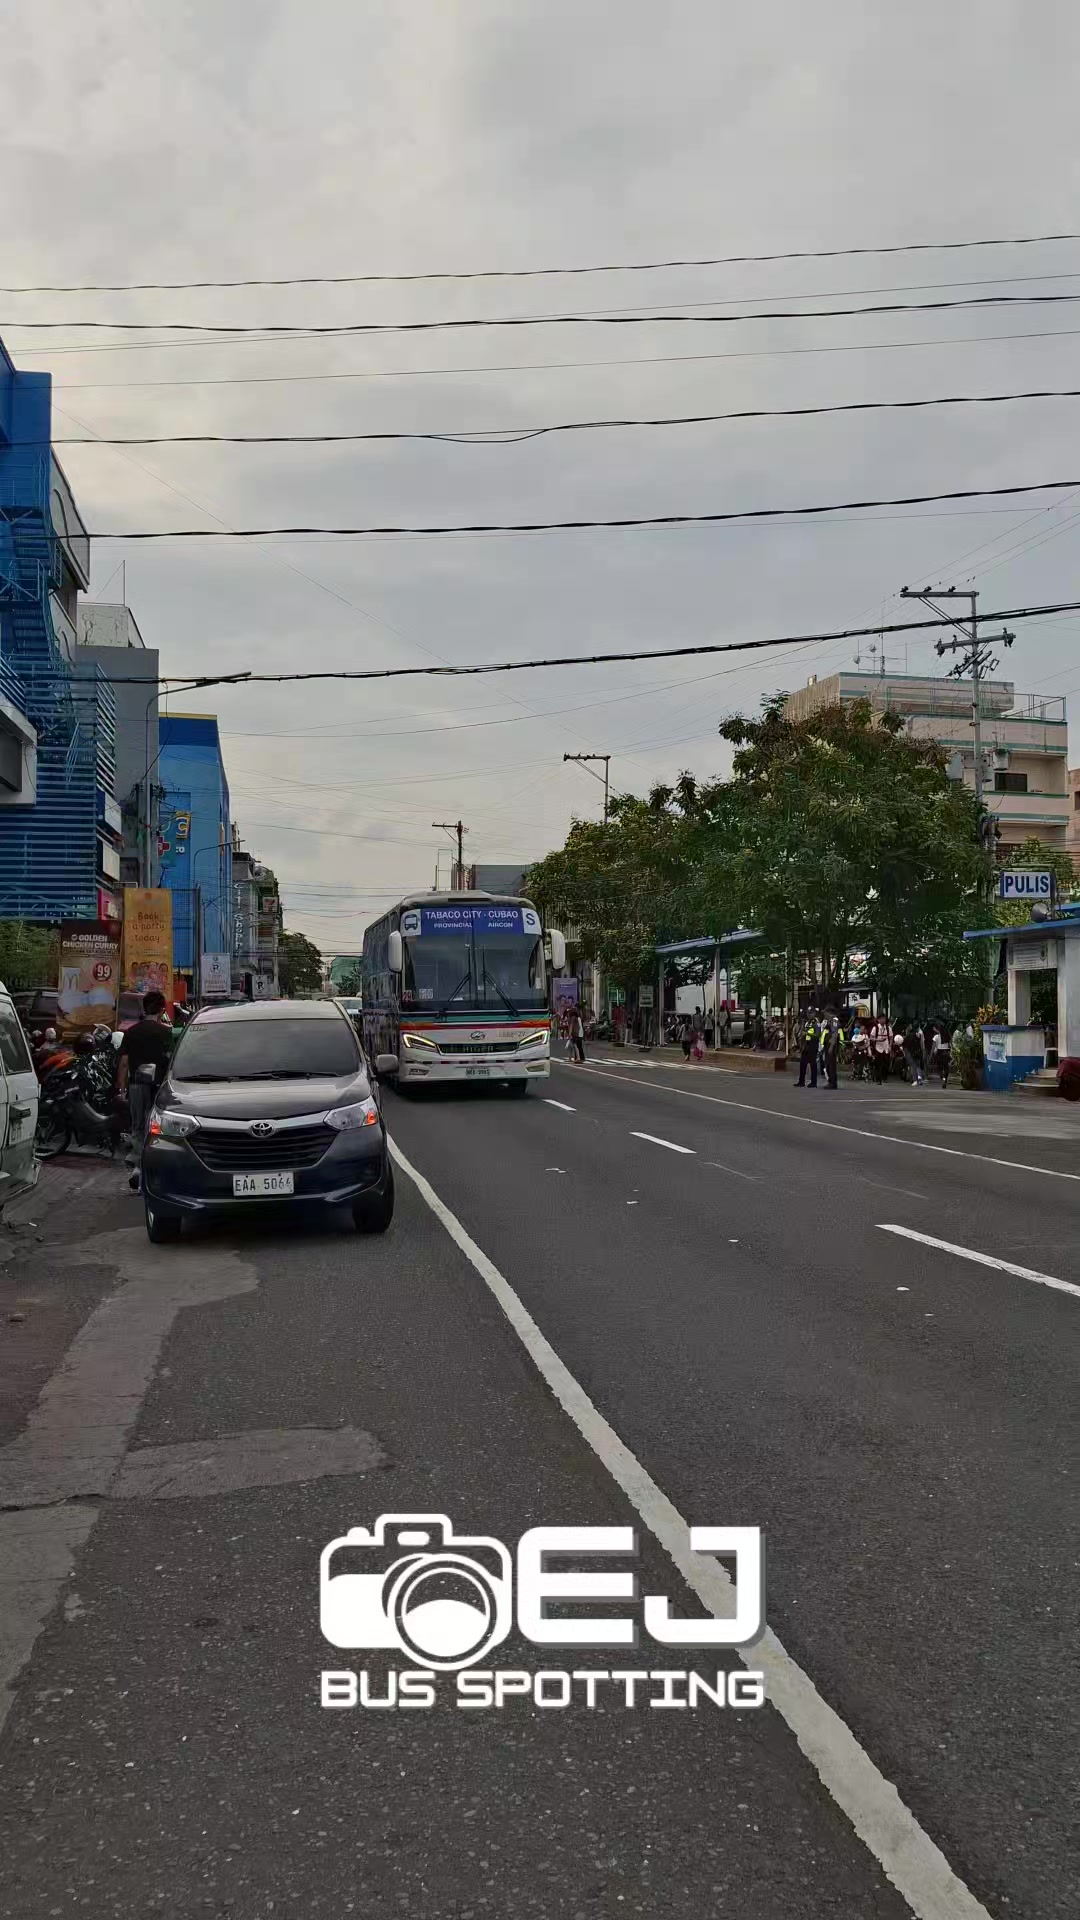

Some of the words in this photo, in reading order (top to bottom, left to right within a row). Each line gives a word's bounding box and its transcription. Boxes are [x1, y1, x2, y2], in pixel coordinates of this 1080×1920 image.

[1005, 875, 1049, 893] PULIS
[138, 911, 159, 921] Book
[425, 911, 460, 919] TABACO
[463, 911, 482, 919] CITY
[488, 910, 518, 918] CUBAO
[526, 913, 536, 926] S
[140, 921, 165, 932] party
[78, 934, 109, 942] GOLDEN
[134, 934, 160, 945] today
[62, 940, 93, 949] CHICKEN
[94, 942, 119, 950] CURRY
[96, 965, 111, 978] 99
[235, 1179, 256, 1192] EAA
